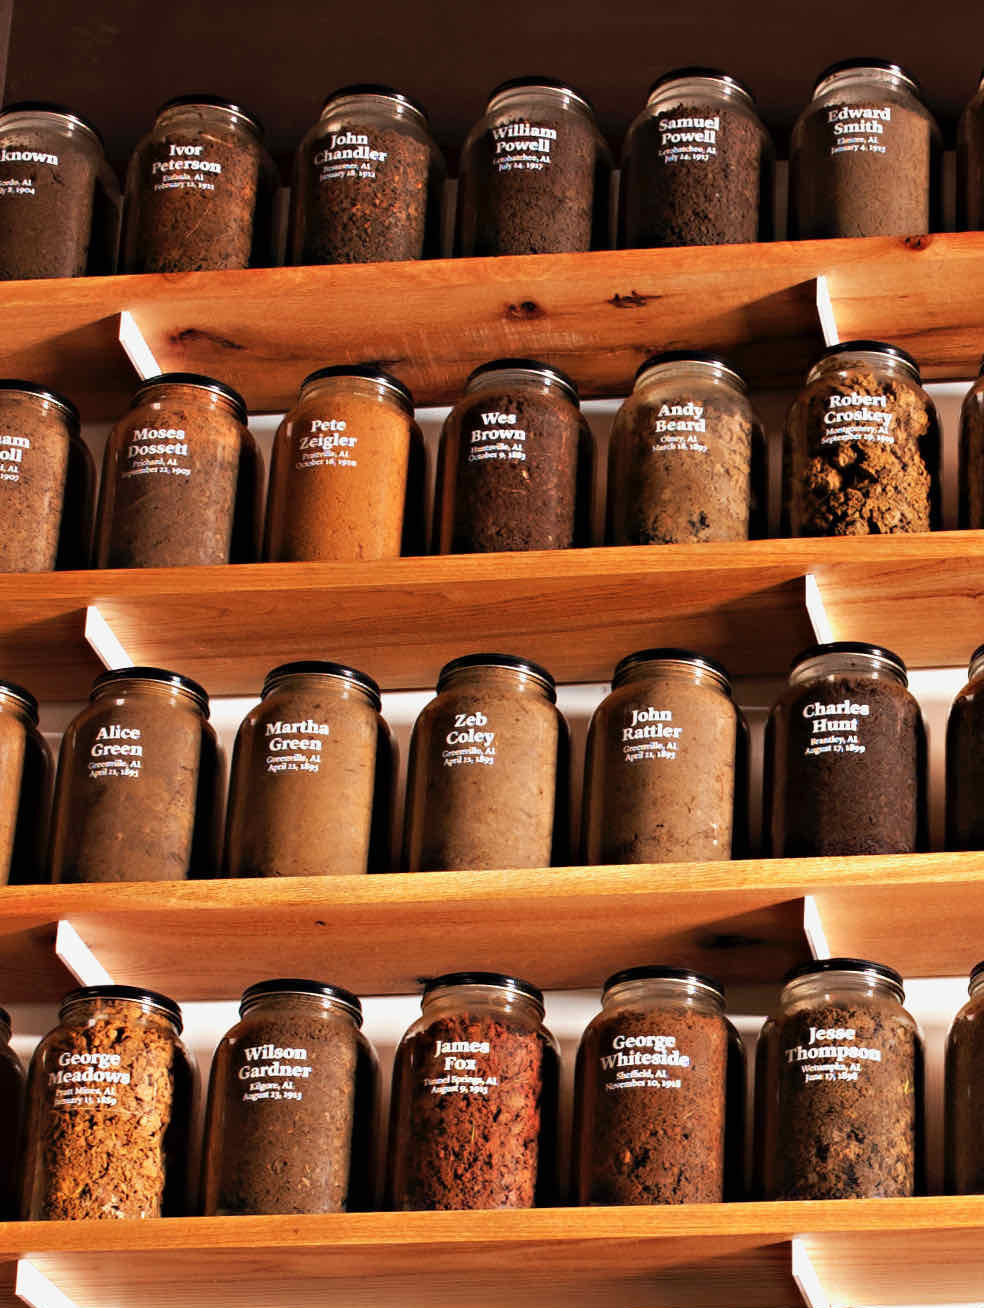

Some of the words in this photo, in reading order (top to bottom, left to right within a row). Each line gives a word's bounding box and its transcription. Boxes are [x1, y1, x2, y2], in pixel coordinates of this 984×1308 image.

[828, 107, 891, 123] Edward
[493, 124, 557, 140] William
[658, 117, 720, 132] Samuel
[833, 120, 883, 135] Smith
[331, 132, 368, 149] John
[496, 138, 550, 153] Powell
[662, 130, 716, 145] Powell
[169, 144, 203, 156] Ivor
[314, 146, 388, 165] Chandler
[152, 158, 222, 174] Peterson
[830, 392, 887, 408] Robert
[481, 412, 517, 425] Wes
[658, 402, 704, 419] Andy
[311, 419, 346, 433] Pete
[655, 418, 706, 432] Beard
[133, 428, 185, 441] Moses
[299, 432, 357, 449] Zeigler
[471, 428, 525, 443] Brown
[128, 443, 188, 458] Dossett
[632, 708, 672, 724] John
[803, 700, 870, 718] Charles
[265, 719, 329, 736] Martha
[455, 712, 487, 727] Zeb
[812, 719, 858, 733] Hunt
[96, 725, 141, 740] Alice
[446, 729, 494, 746] Coley
[623, 724, 682, 741] Rattler
[91, 744, 142, 757] Green
[269, 737, 322, 751] Green
[612, 1035, 676, 1053] George
[808, 1027, 856, 1045] Jesse
[245, 1044, 307, 1061] Wilson
[434, 1040, 490, 1057] James
[785, 1046, 881, 1063] Thompson
[59, 1052, 121, 1068] George
[443, 1057, 477, 1071] Fox
[600, 1050, 690, 1070] Whiteside
[48, 1068, 130, 1085] Meadows
[238, 1061, 312, 1079] Gardner
